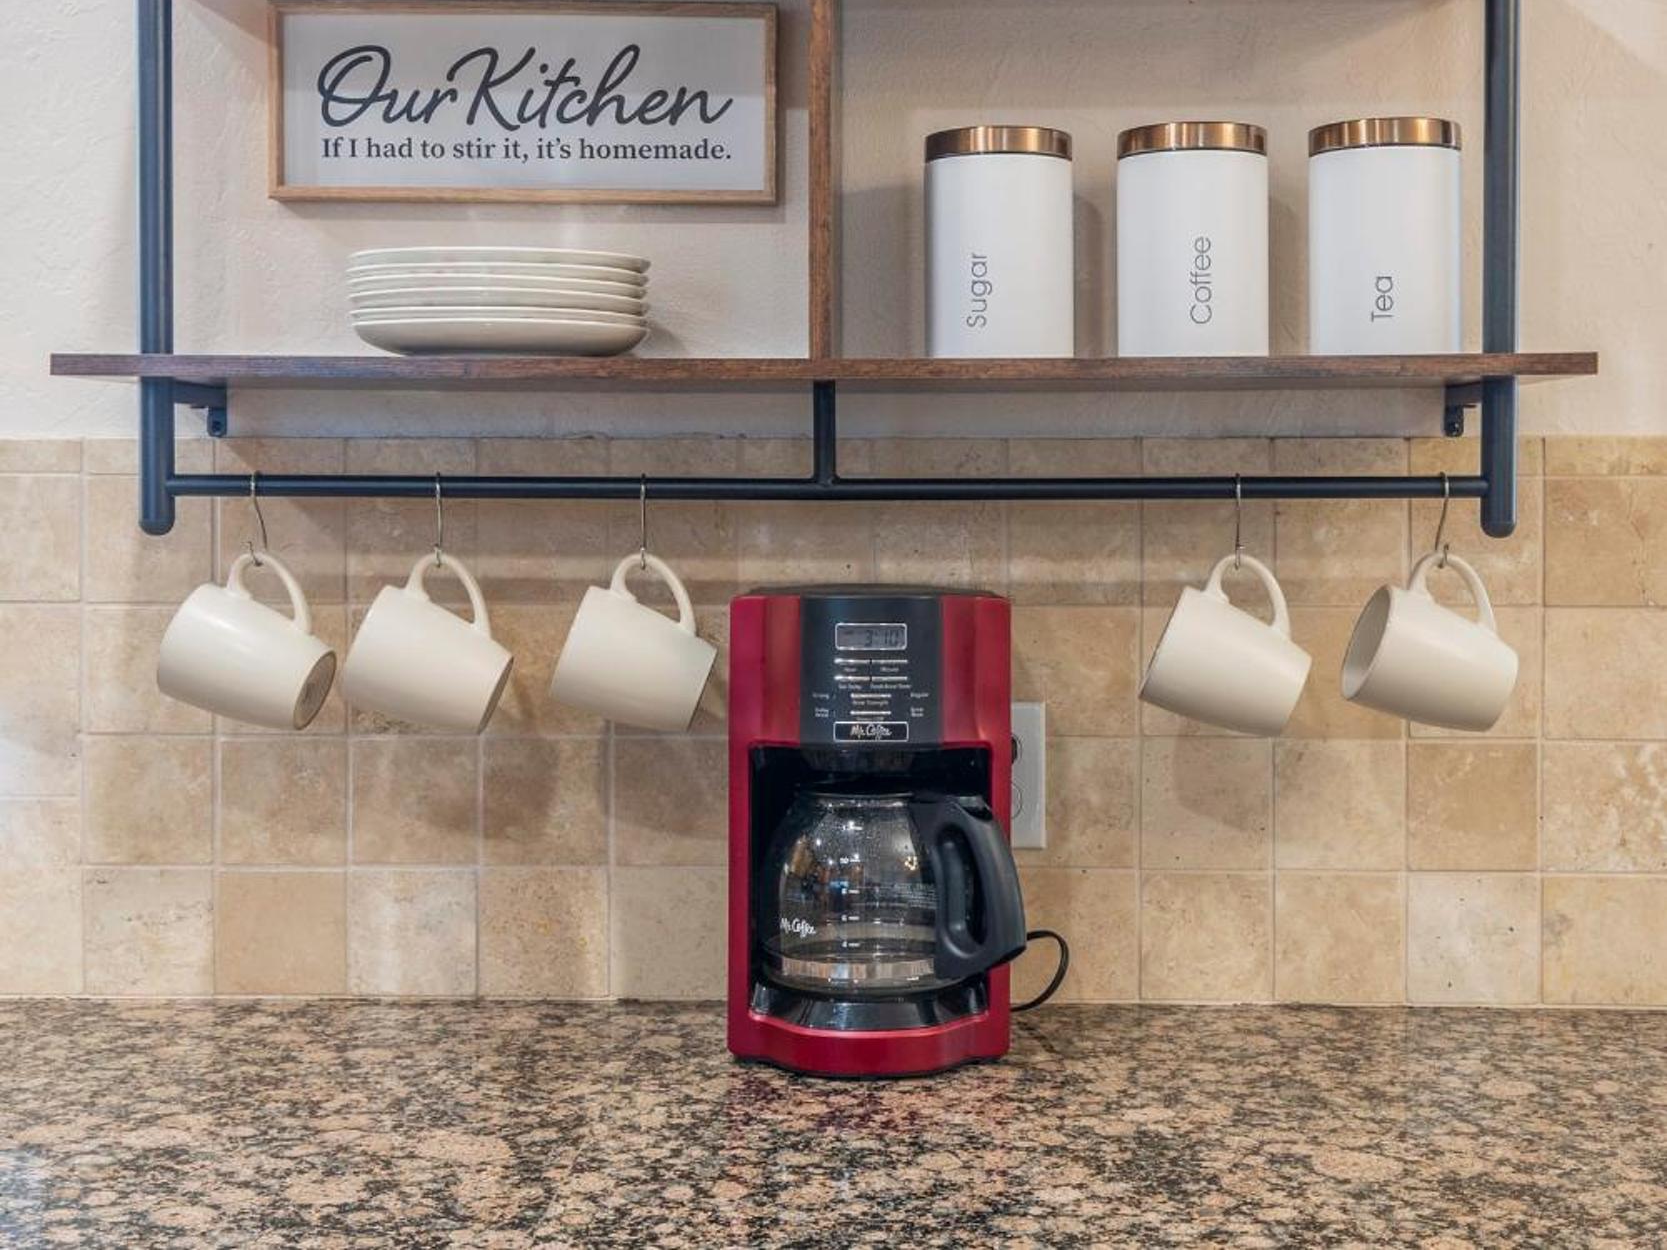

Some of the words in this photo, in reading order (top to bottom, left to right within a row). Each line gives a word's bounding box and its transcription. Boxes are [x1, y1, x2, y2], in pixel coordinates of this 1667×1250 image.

[317, 44, 458, 127] Our
[447, 44, 734, 132] Kitchen
[321, 136, 344, 158] If
[349, 137, 358, 158] I
[366, 136, 414, 158] had
[420, 139, 446, 159] to
[452, 137, 497, 159] stir
[503, 137, 529, 162] it,
[536, 137, 572, 159] it's
[579, 137, 732, 160] homemade.
[965, 251, 993, 329] Sugar
[1189, 236, 1212, 326] Coffee
[1370, 274, 1395, 323] Tea
